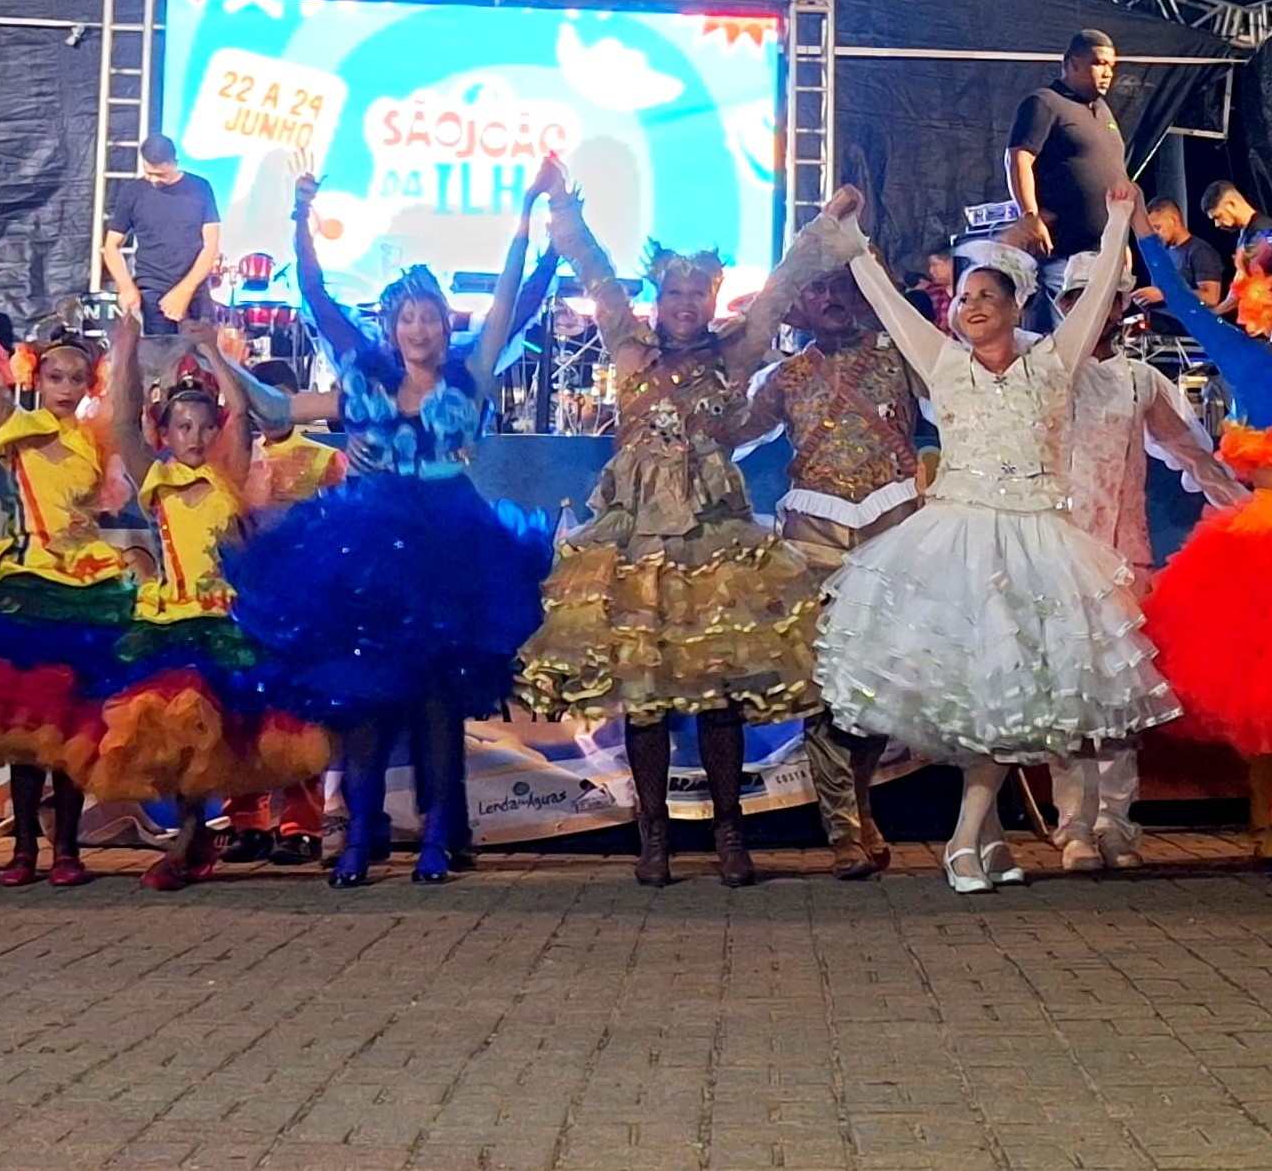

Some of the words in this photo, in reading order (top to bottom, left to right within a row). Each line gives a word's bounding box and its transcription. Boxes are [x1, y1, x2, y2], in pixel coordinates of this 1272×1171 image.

[218, 71, 255, 102] 22
[260, 83, 280, 109] A
[224, 107, 314, 149] JUNHO
[431, 161, 526, 215] ILH
[776, 770, 806, 785] COSTA
